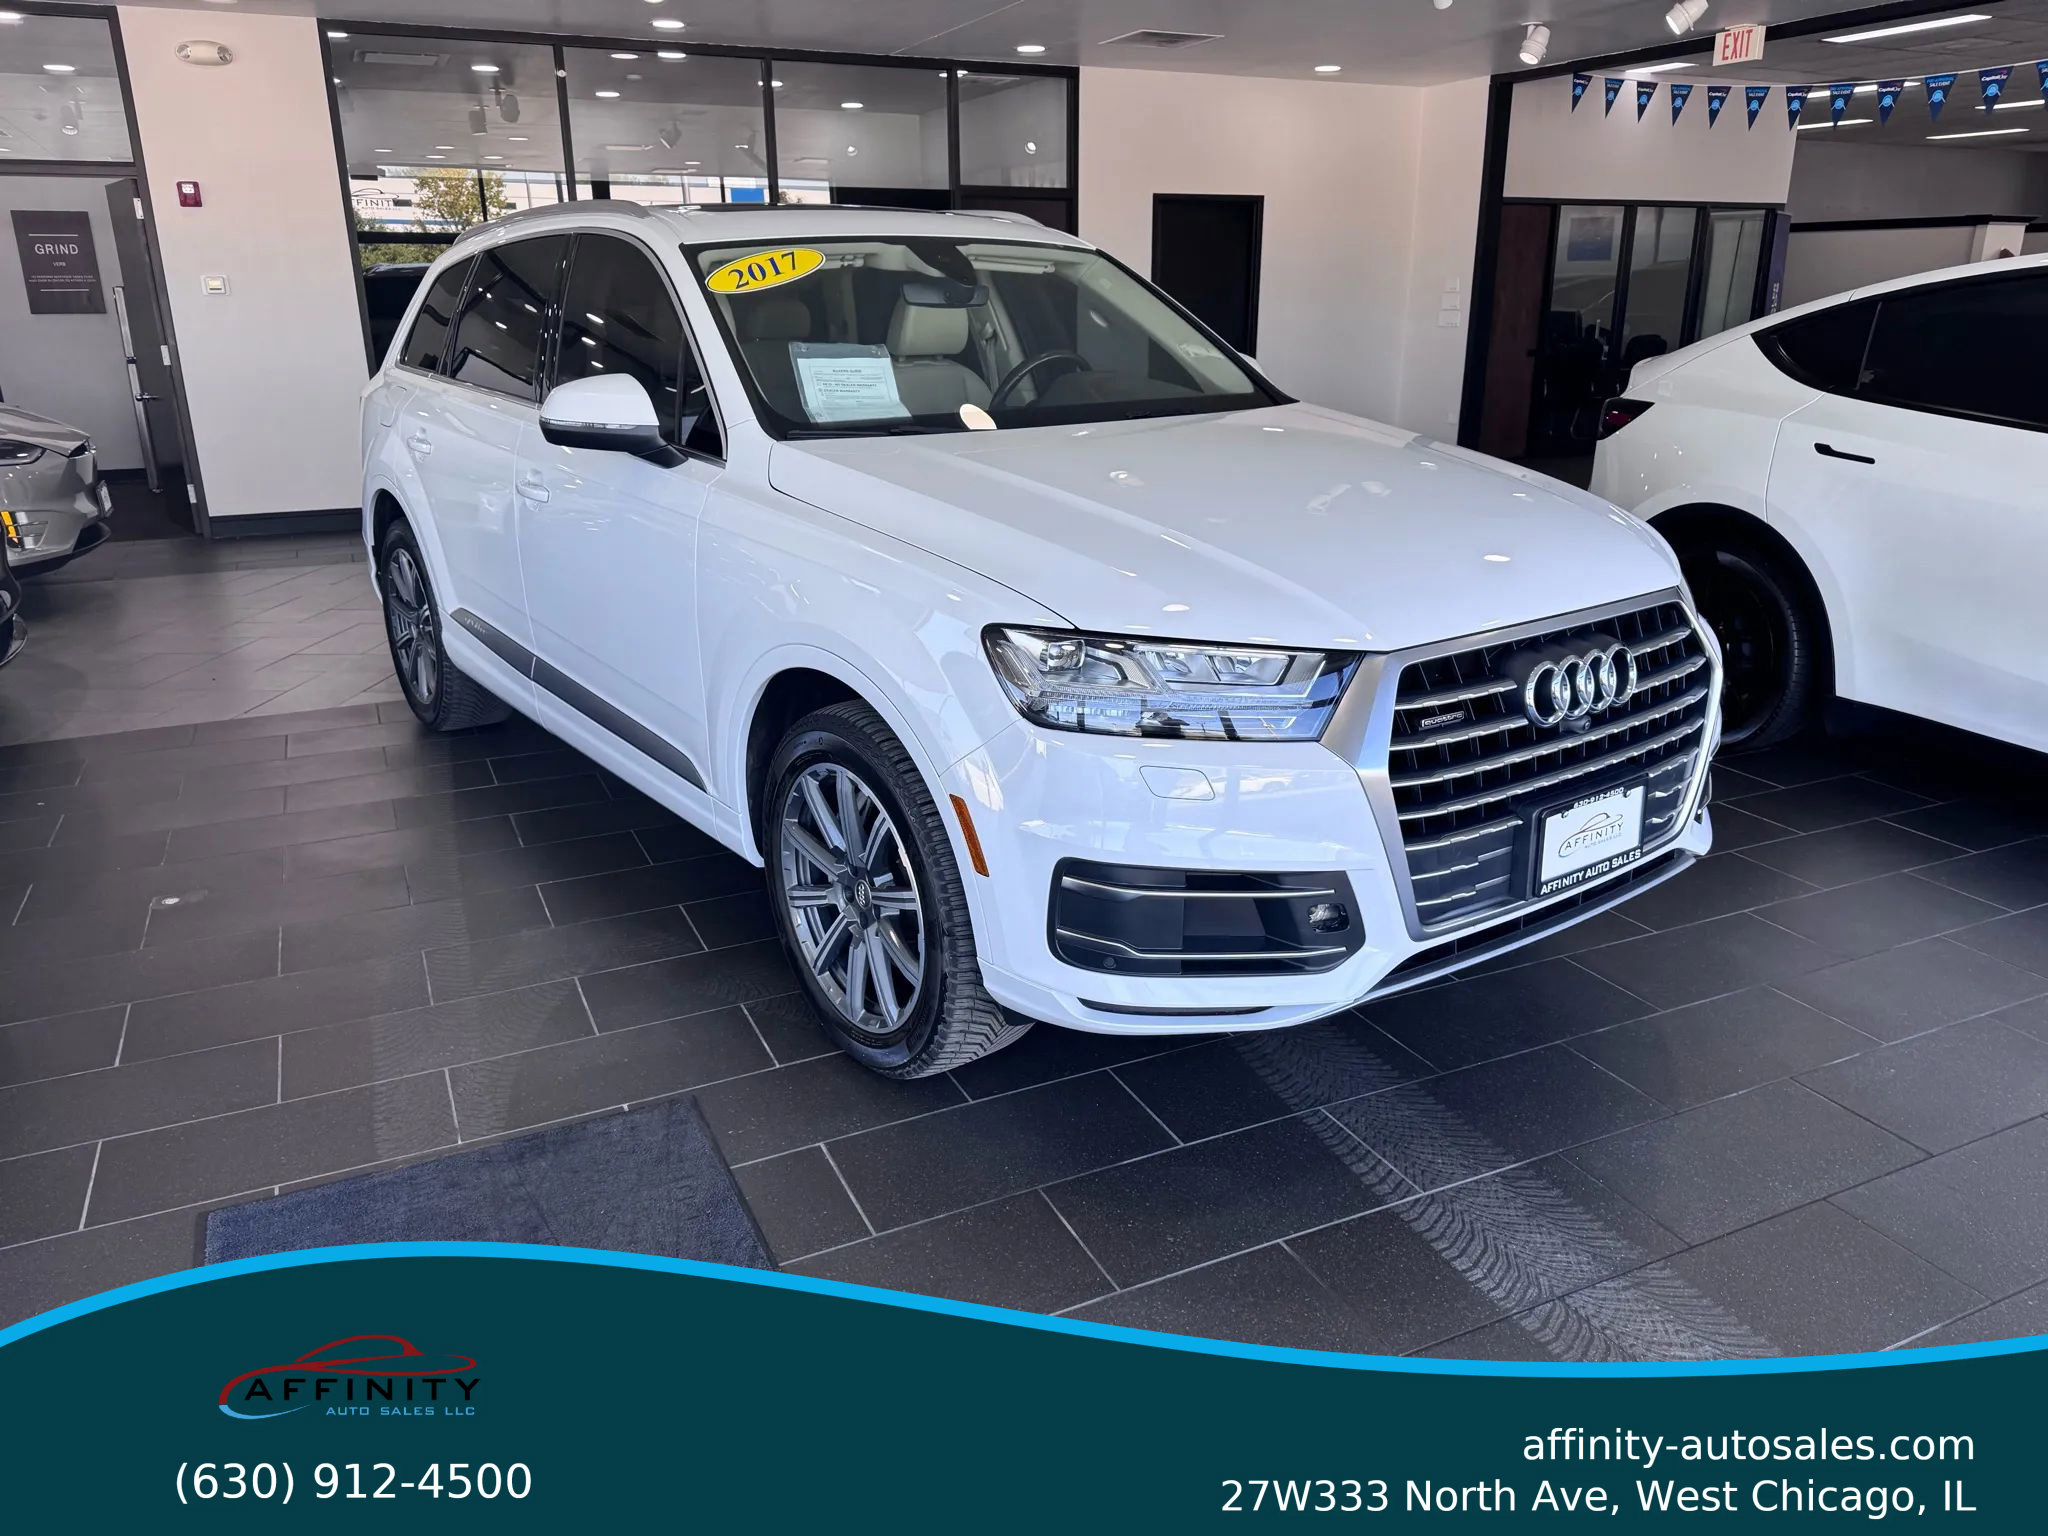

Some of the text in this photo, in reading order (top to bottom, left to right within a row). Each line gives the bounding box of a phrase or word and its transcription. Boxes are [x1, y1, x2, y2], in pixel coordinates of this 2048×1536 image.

[1722, 29, 1754, 60] EXIT
[352, 198, 400, 207] FINITY
[34, 243, 79, 255] GRIND
[728, 252, 796, 289] 2017
[1424, 713, 1463, 726] quattro
[1573, 787, 1624, 809] 630-912-4500
[1564, 822, 1624, 851] AFFINITY
[1540, 849, 1642, 895] AFFINITY AUTO SALES
